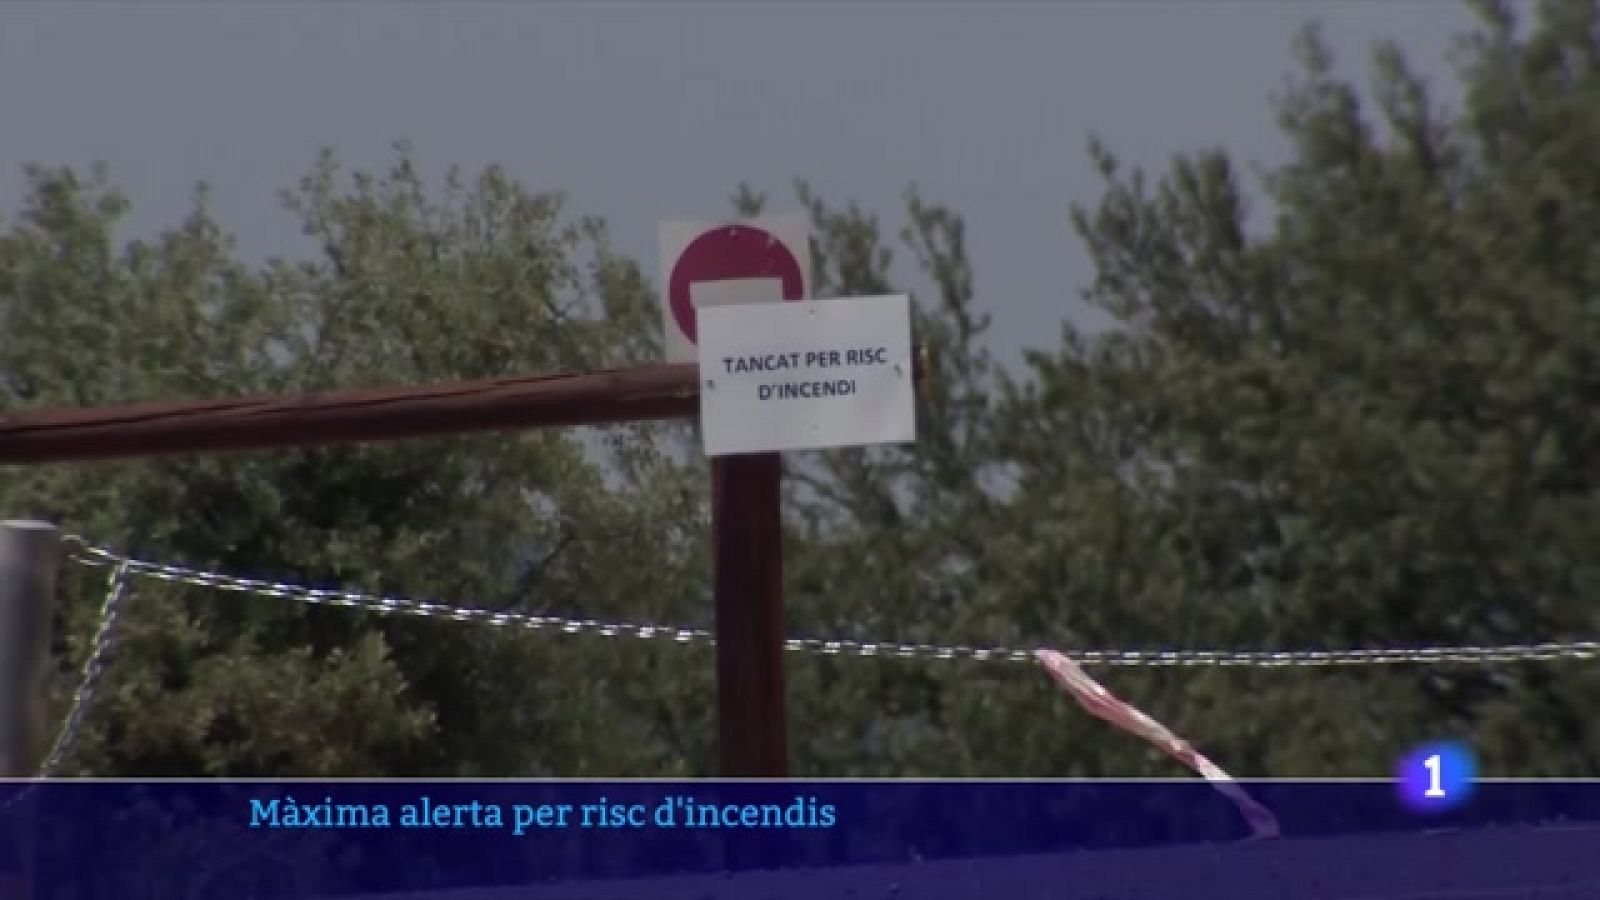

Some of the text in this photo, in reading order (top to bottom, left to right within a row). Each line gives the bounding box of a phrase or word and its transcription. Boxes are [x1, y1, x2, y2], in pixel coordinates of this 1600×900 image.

[722, 347, 887, 373] TANCAT PER RISC
